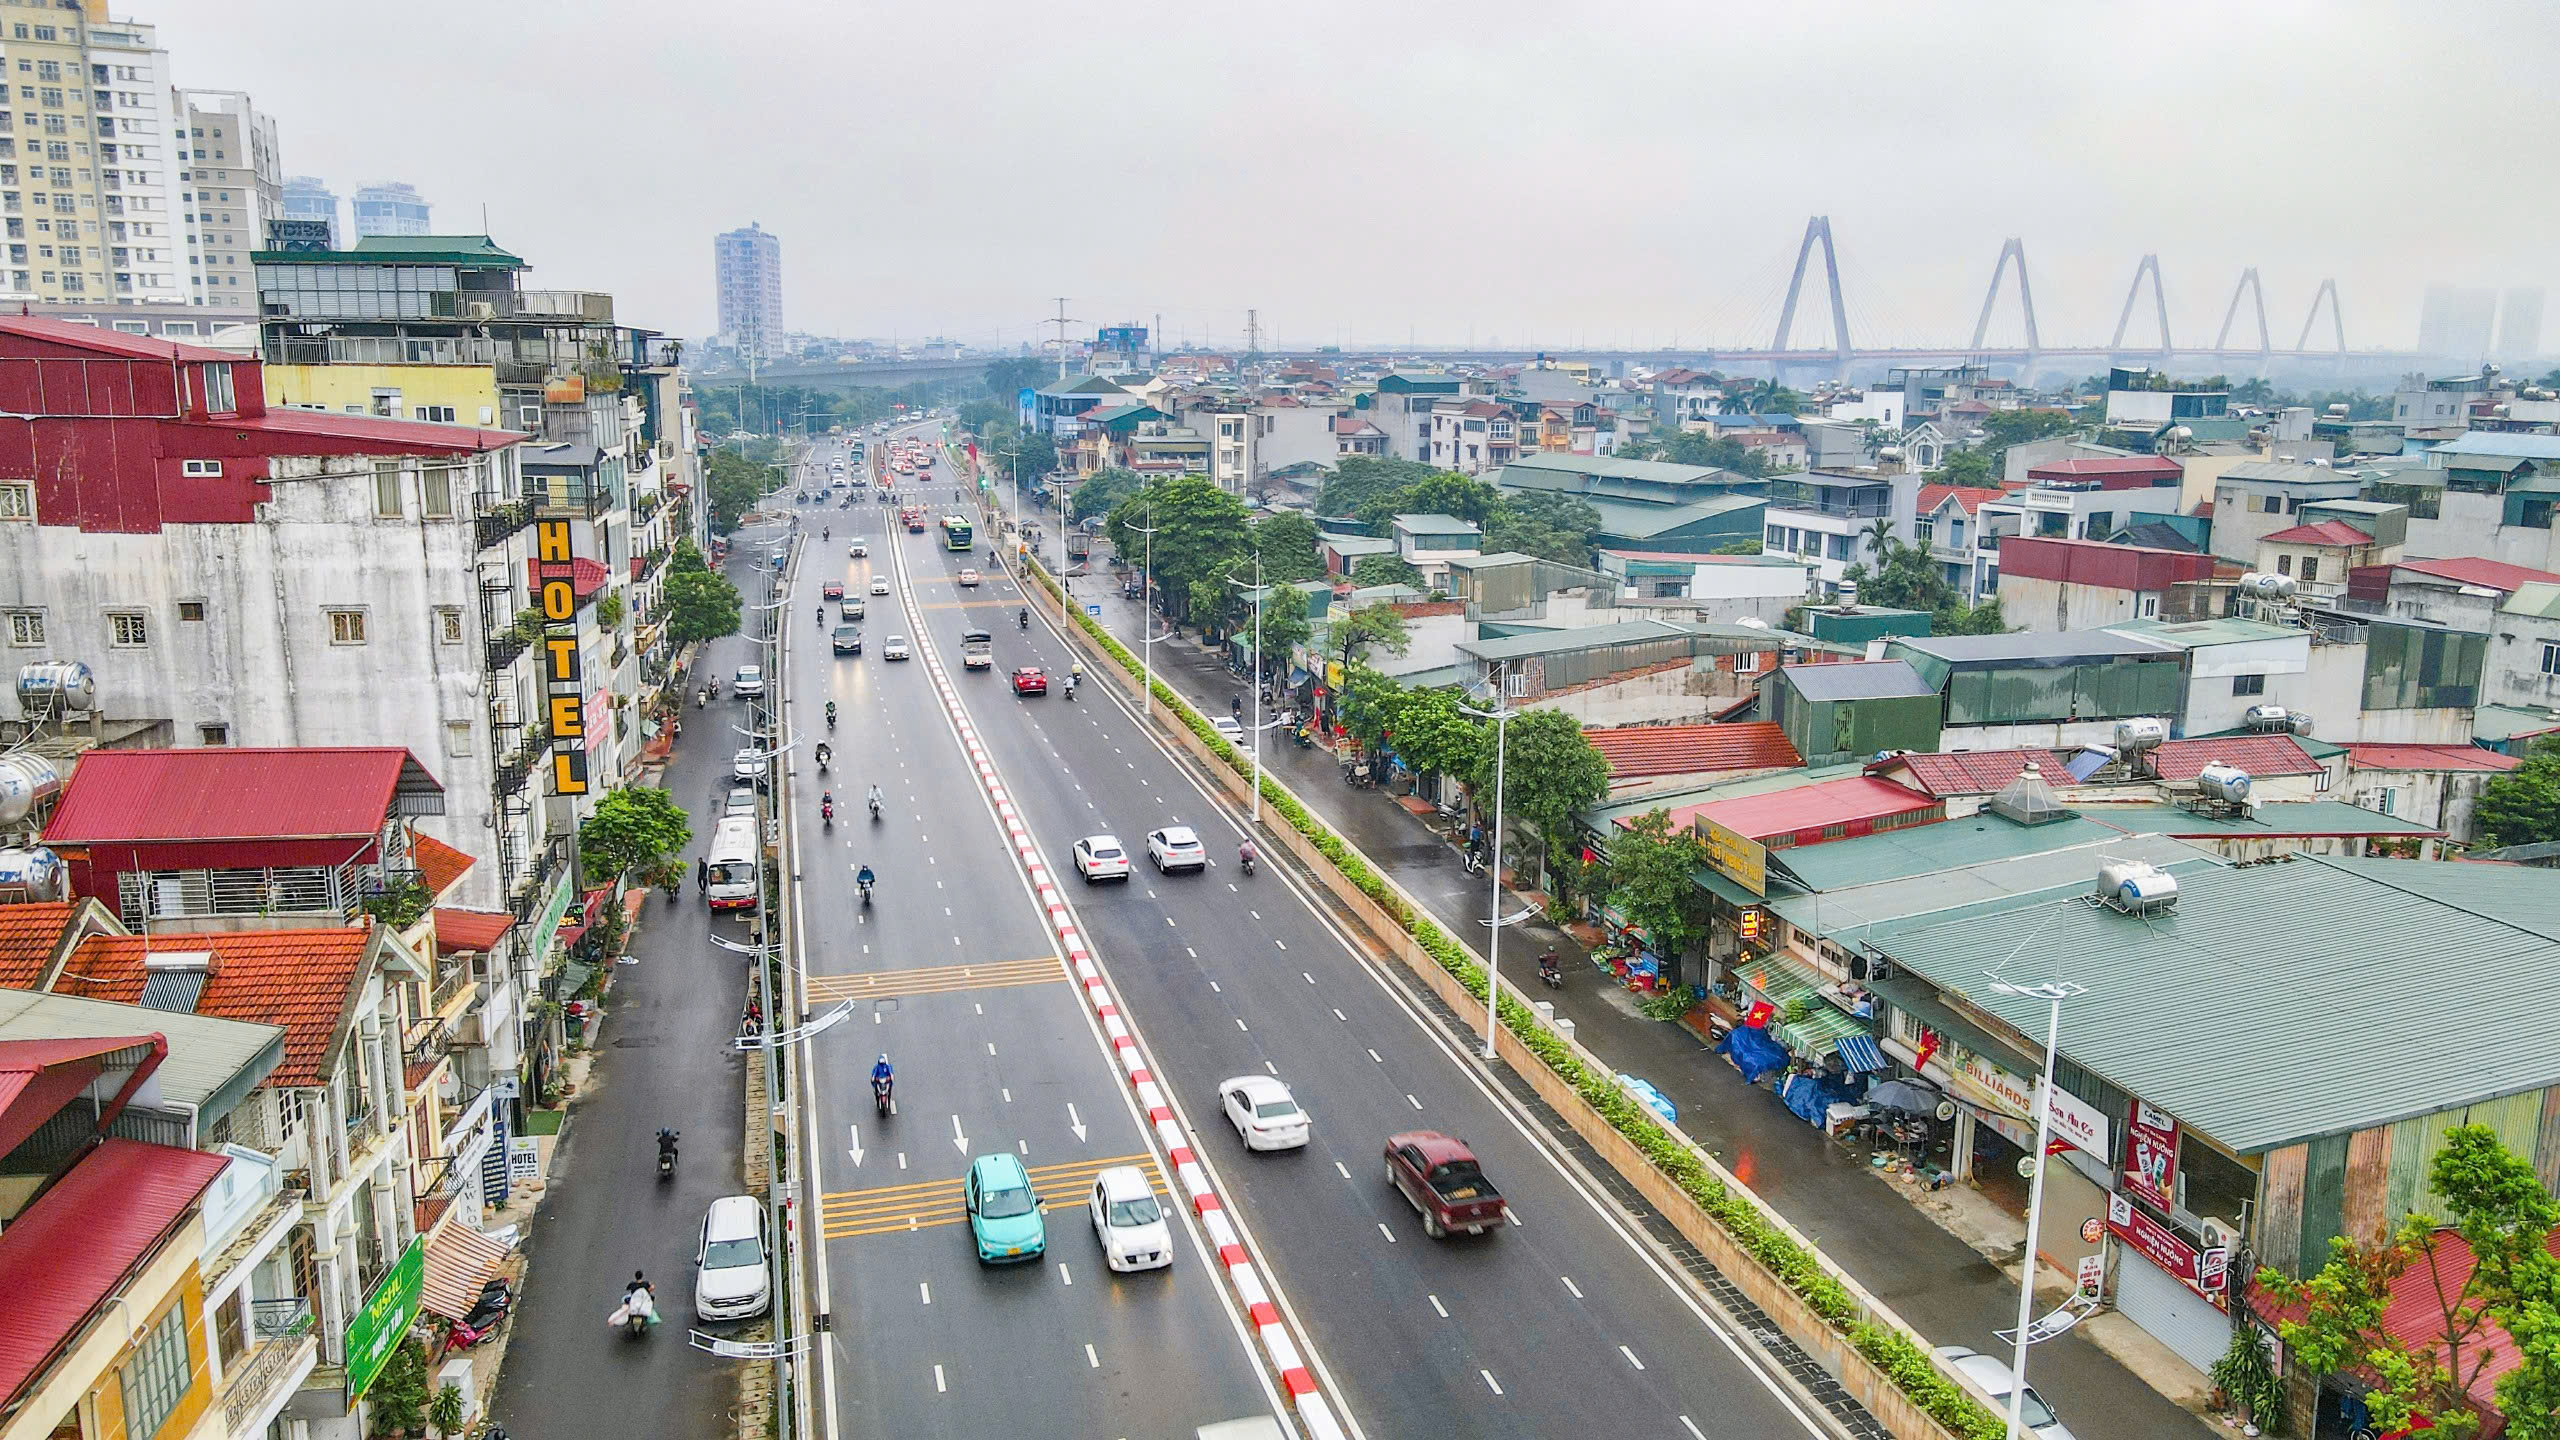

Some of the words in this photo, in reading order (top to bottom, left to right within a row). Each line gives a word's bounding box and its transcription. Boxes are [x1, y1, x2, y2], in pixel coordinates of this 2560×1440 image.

[539, 522, 586, 793] HOTEL
[1966, 1062, 2030, 1110] BILLIARDS
[2144, 1110, 2166, 1127] CAMEL
[511, 1152, 537, 1165] HOTEL
[2135, 1225, 2160, 1250] NGHIỆN
[371, 1270, 403, 1326] NISHU
